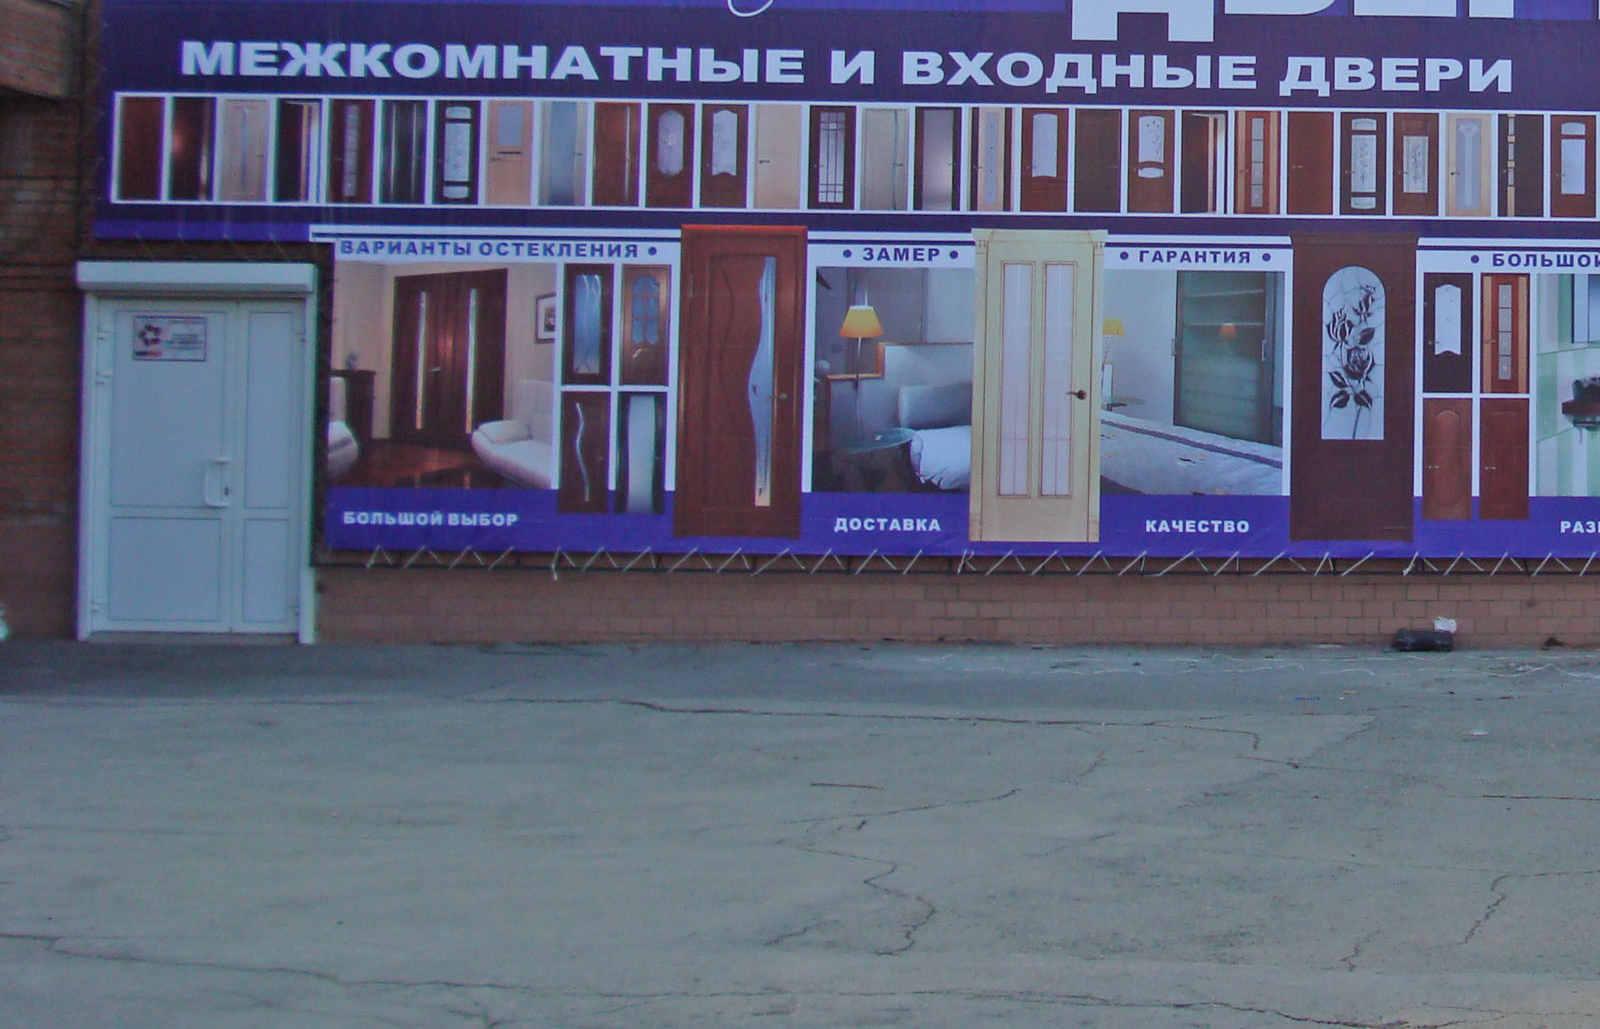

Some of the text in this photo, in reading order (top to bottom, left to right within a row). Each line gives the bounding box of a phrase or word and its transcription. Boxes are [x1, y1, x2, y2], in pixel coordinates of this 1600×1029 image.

[183, 42, 804, 83] МЕЖКОМНАТНЫЕ
[831, 51, 874, 84] И
[903, 52, 1256, 93] ВХОДНЫЕ
[1280, 57, 1511, 96] ДВЕРИ
[340, 240, 640, 258] ВАРИАНТЫ ОСТЕКЛЕНИЯ
[862, 246, 942, 262] ЗАМЕР
[1138, 248, 1253, 264] ГАРАНТИЯ
[344, 511, 518, 526] БОЛЬШОЙ ВЫБОР
[834, 518, 941, 532] ДОСТАВКА
[1146, 520, 1249, 532] КАЧЕСТВО
